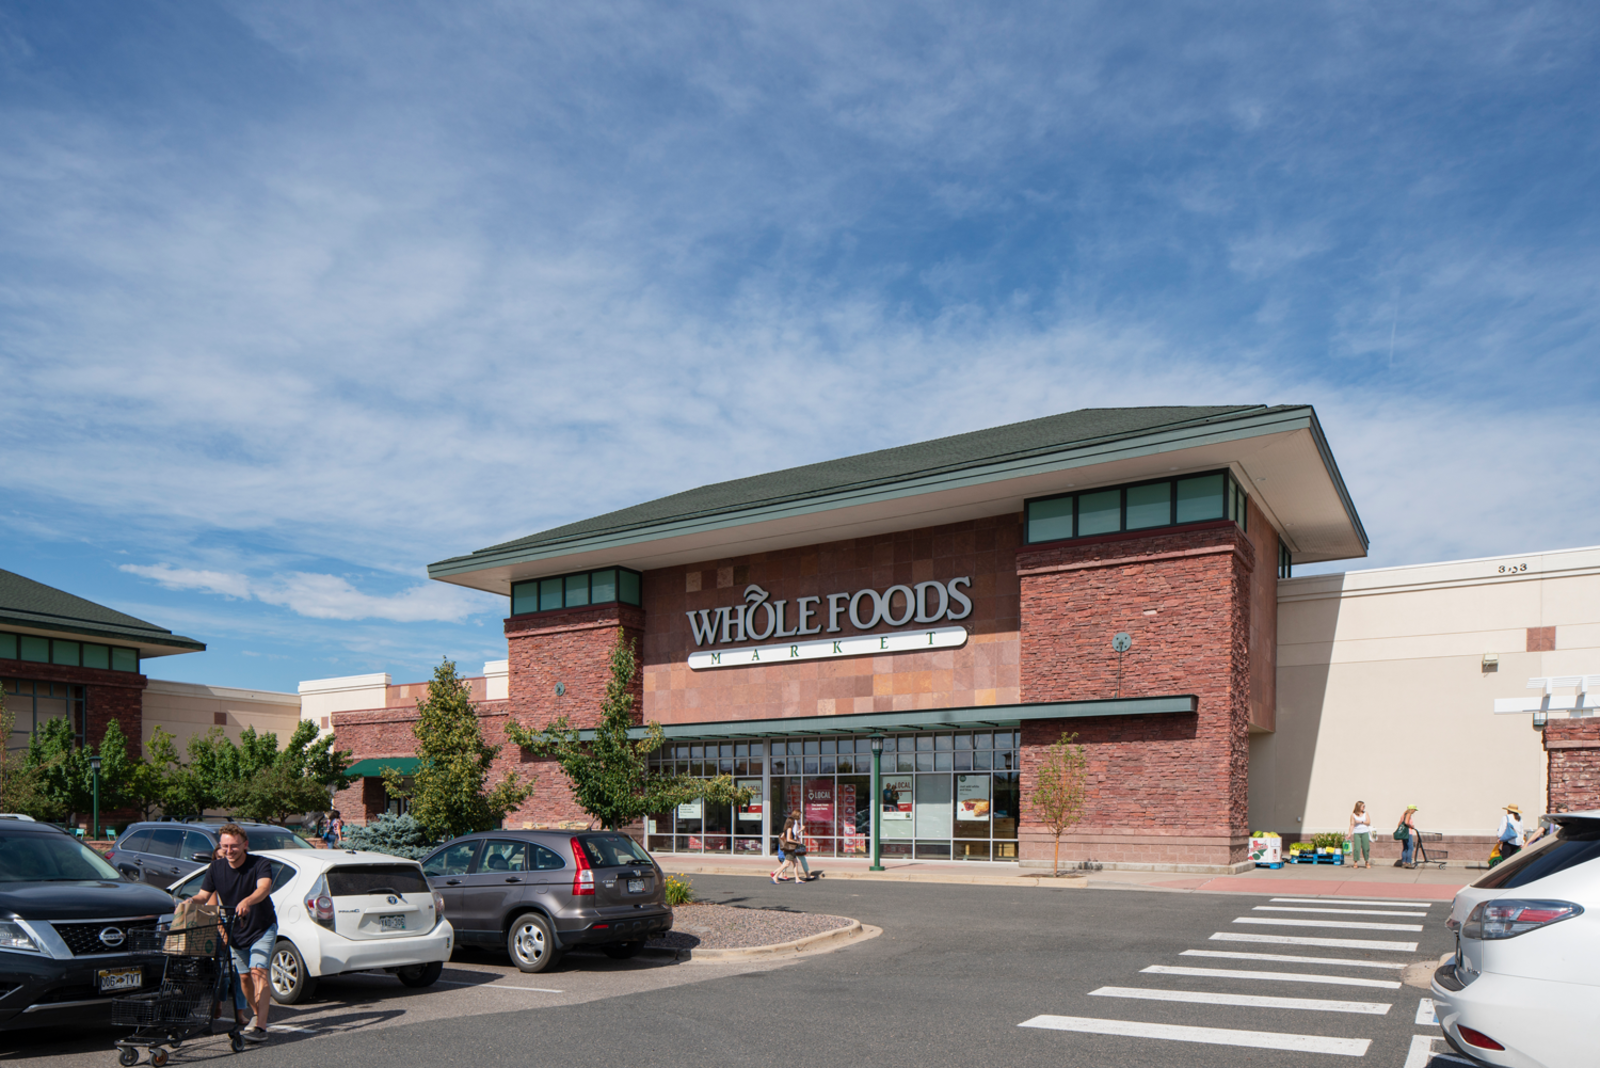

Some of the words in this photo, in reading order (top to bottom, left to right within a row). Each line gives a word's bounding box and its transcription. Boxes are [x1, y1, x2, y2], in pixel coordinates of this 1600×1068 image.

[686, 584, 822, 646] WHOLE
[826, 576, 973, 632] FOODS
[711, 631, 936, 665] MARKET
[814, 791, 831, 799] LOCAL
